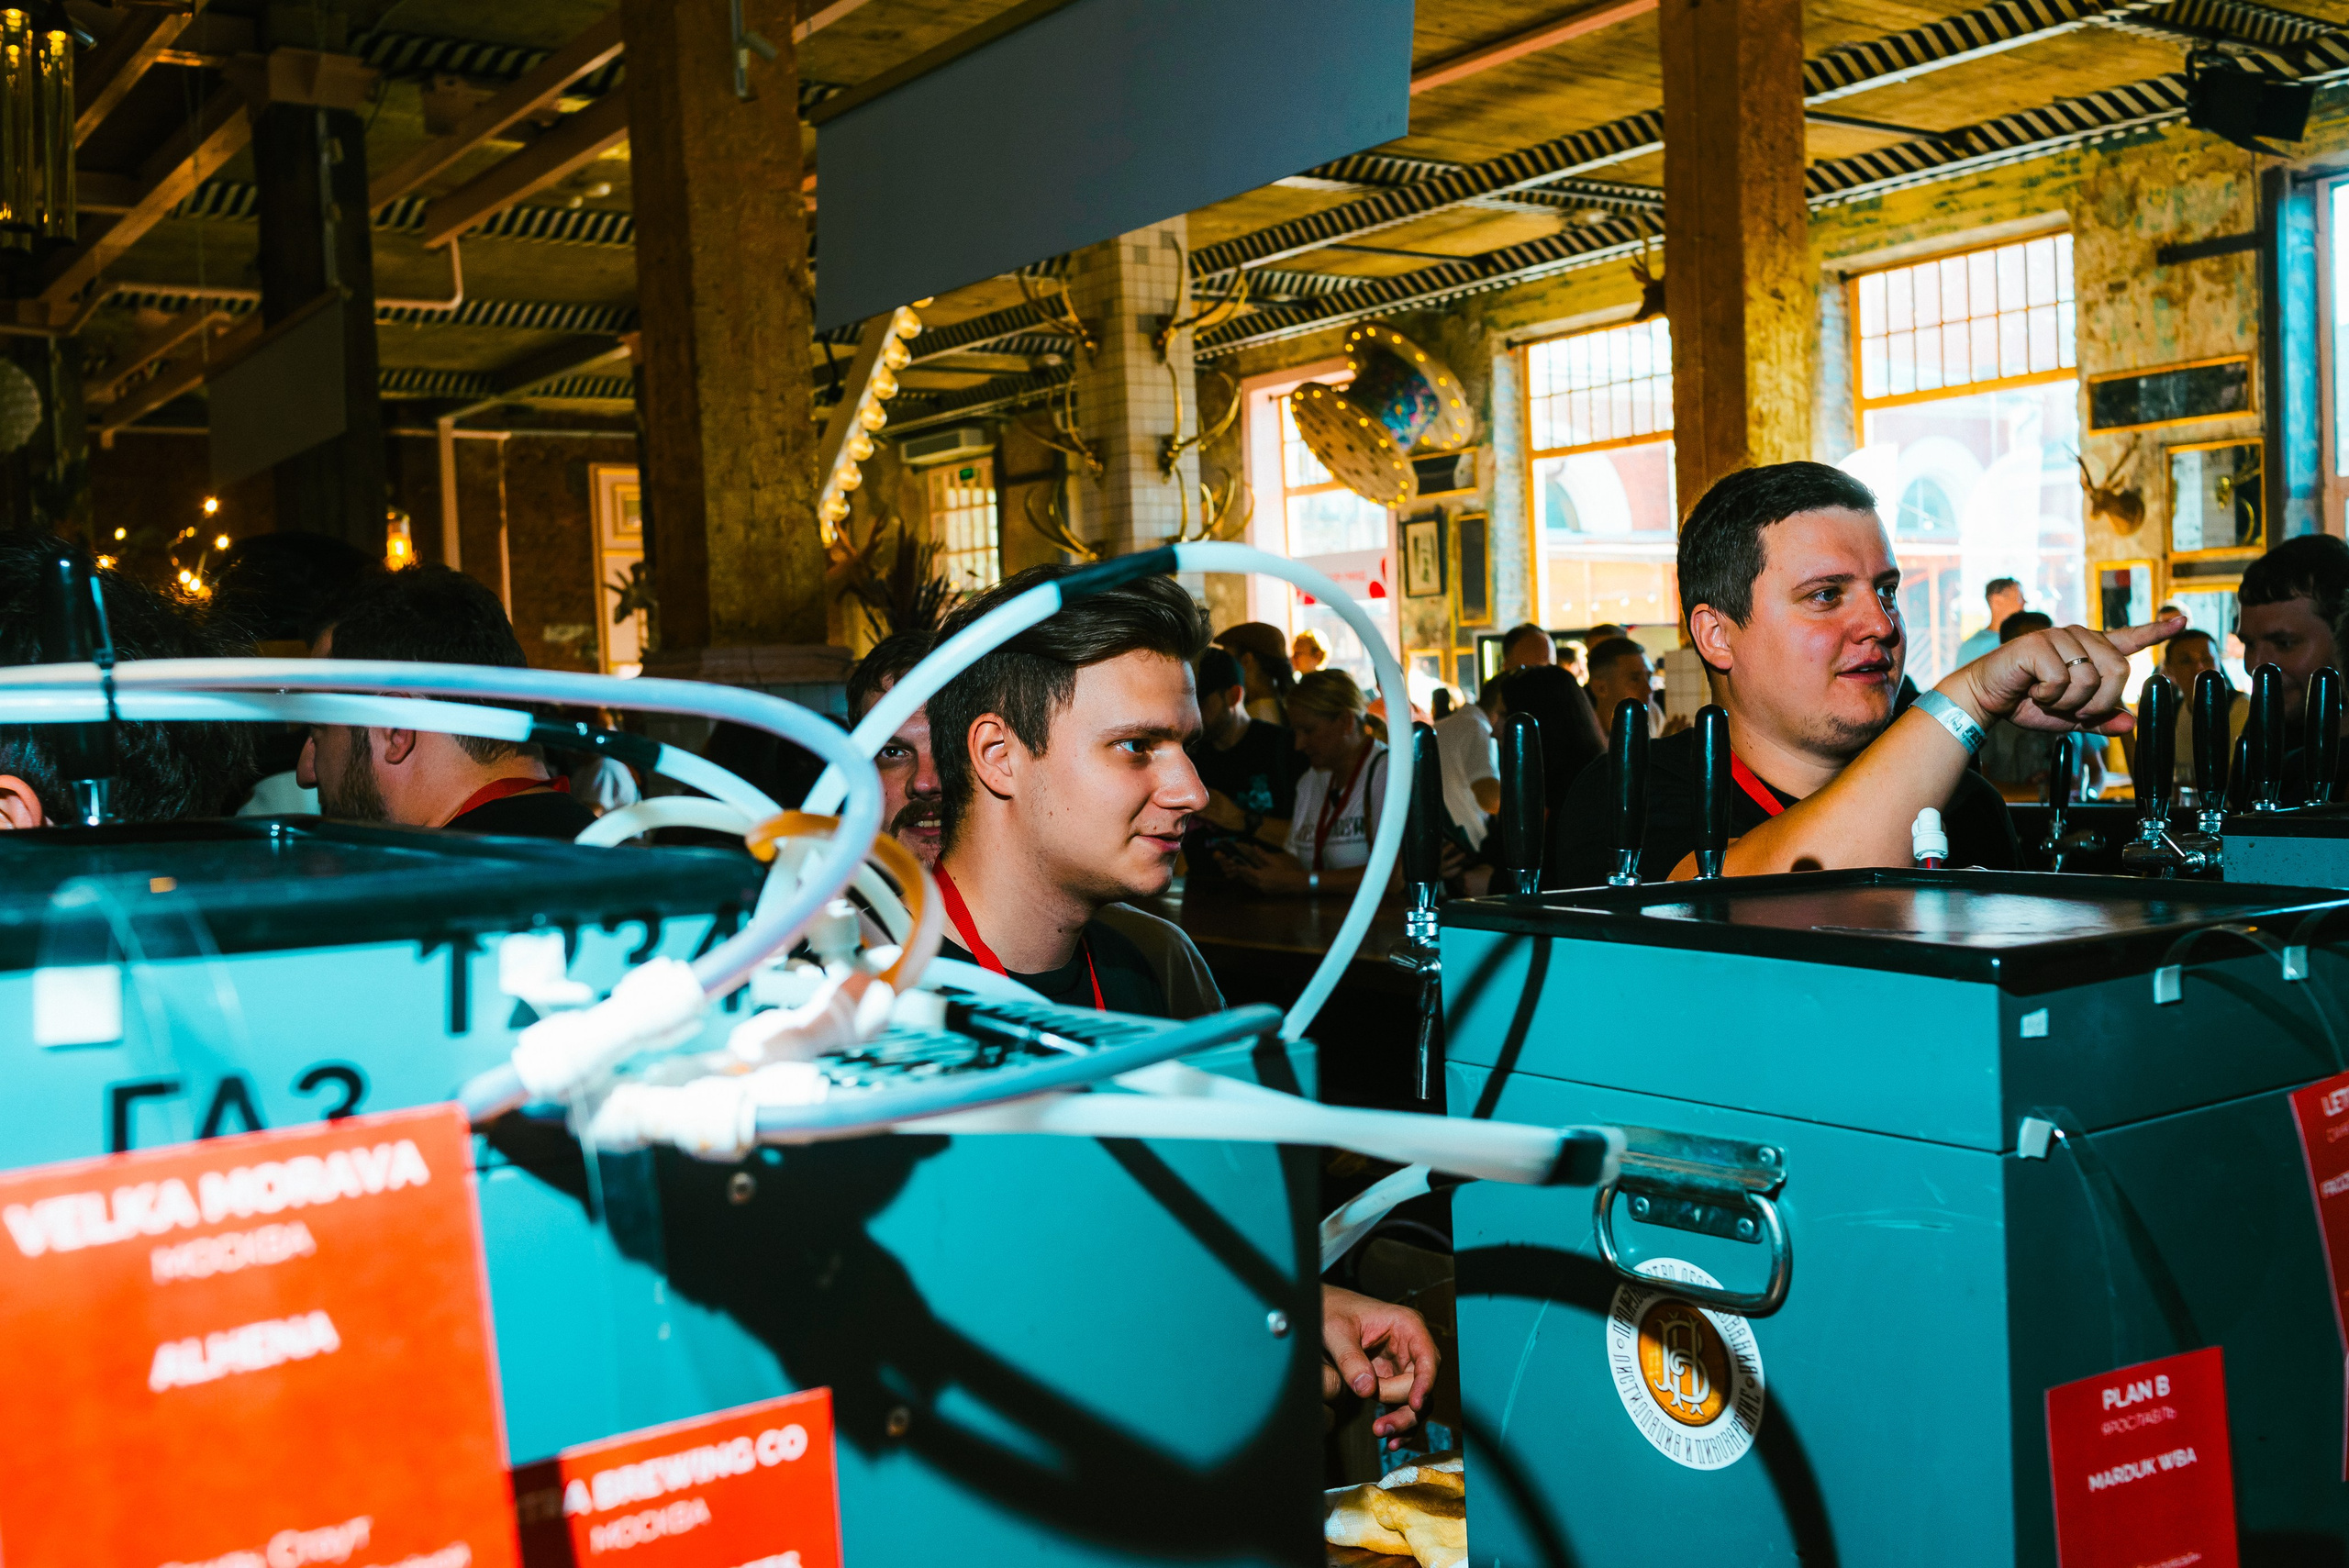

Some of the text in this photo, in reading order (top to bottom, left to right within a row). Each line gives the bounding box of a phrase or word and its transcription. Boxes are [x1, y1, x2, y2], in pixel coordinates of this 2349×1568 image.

[3, 1140, 430, 1257] VELKA MORAVA
[2102, 1374, 2170, 1410] PLAN B
[593, 1437, 756, 1511] BREWING
[756, 1424, 807, 1466] CO
[2087, 1457, 2156, 1492] MARDUK
